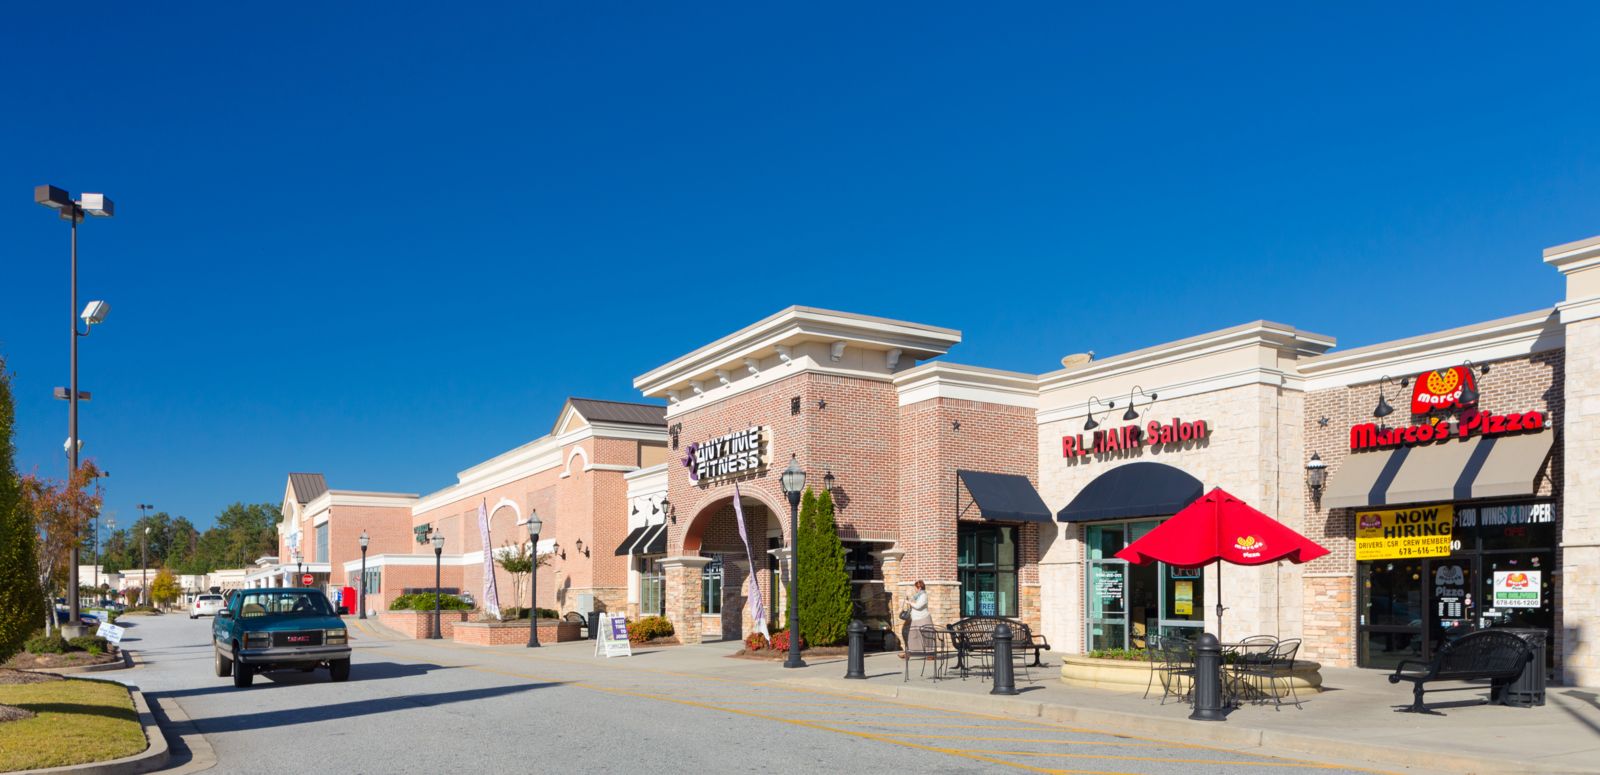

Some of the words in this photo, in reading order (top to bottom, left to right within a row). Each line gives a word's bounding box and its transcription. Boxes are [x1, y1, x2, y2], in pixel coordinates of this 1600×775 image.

[1417, 386, 1464, 404] marco'
[1062, 434, 1086, 458] RL
[1093, 425, 1138, 454] HAIR
[1147, 417, 1206, 445] Salon
[1350, 422, 1450, 449] Marco's
[1458, 409, 1544, 437] Pizza
[697, 426, 759, 463] ANYTIME
[697, 449, 759, 480] FITNESS
[1395, 508, 1439, 525] NOW
[1481, 506, 1508, 526] WINGS
[1511, 506, 1517, 524] &
[1519, 503, 1555, 523] DIPPERS
[1384, 522, 1451, 539] HIRING
[1358, 541, 1383, 549] DRIVERS
[1387, 540, 1398, 548] CSR
[1403, 539, 1420, 547] CREW
[1421, 537, 1451, 545] MEMBERS
[1435, 586, 1464, 597] Pizza
